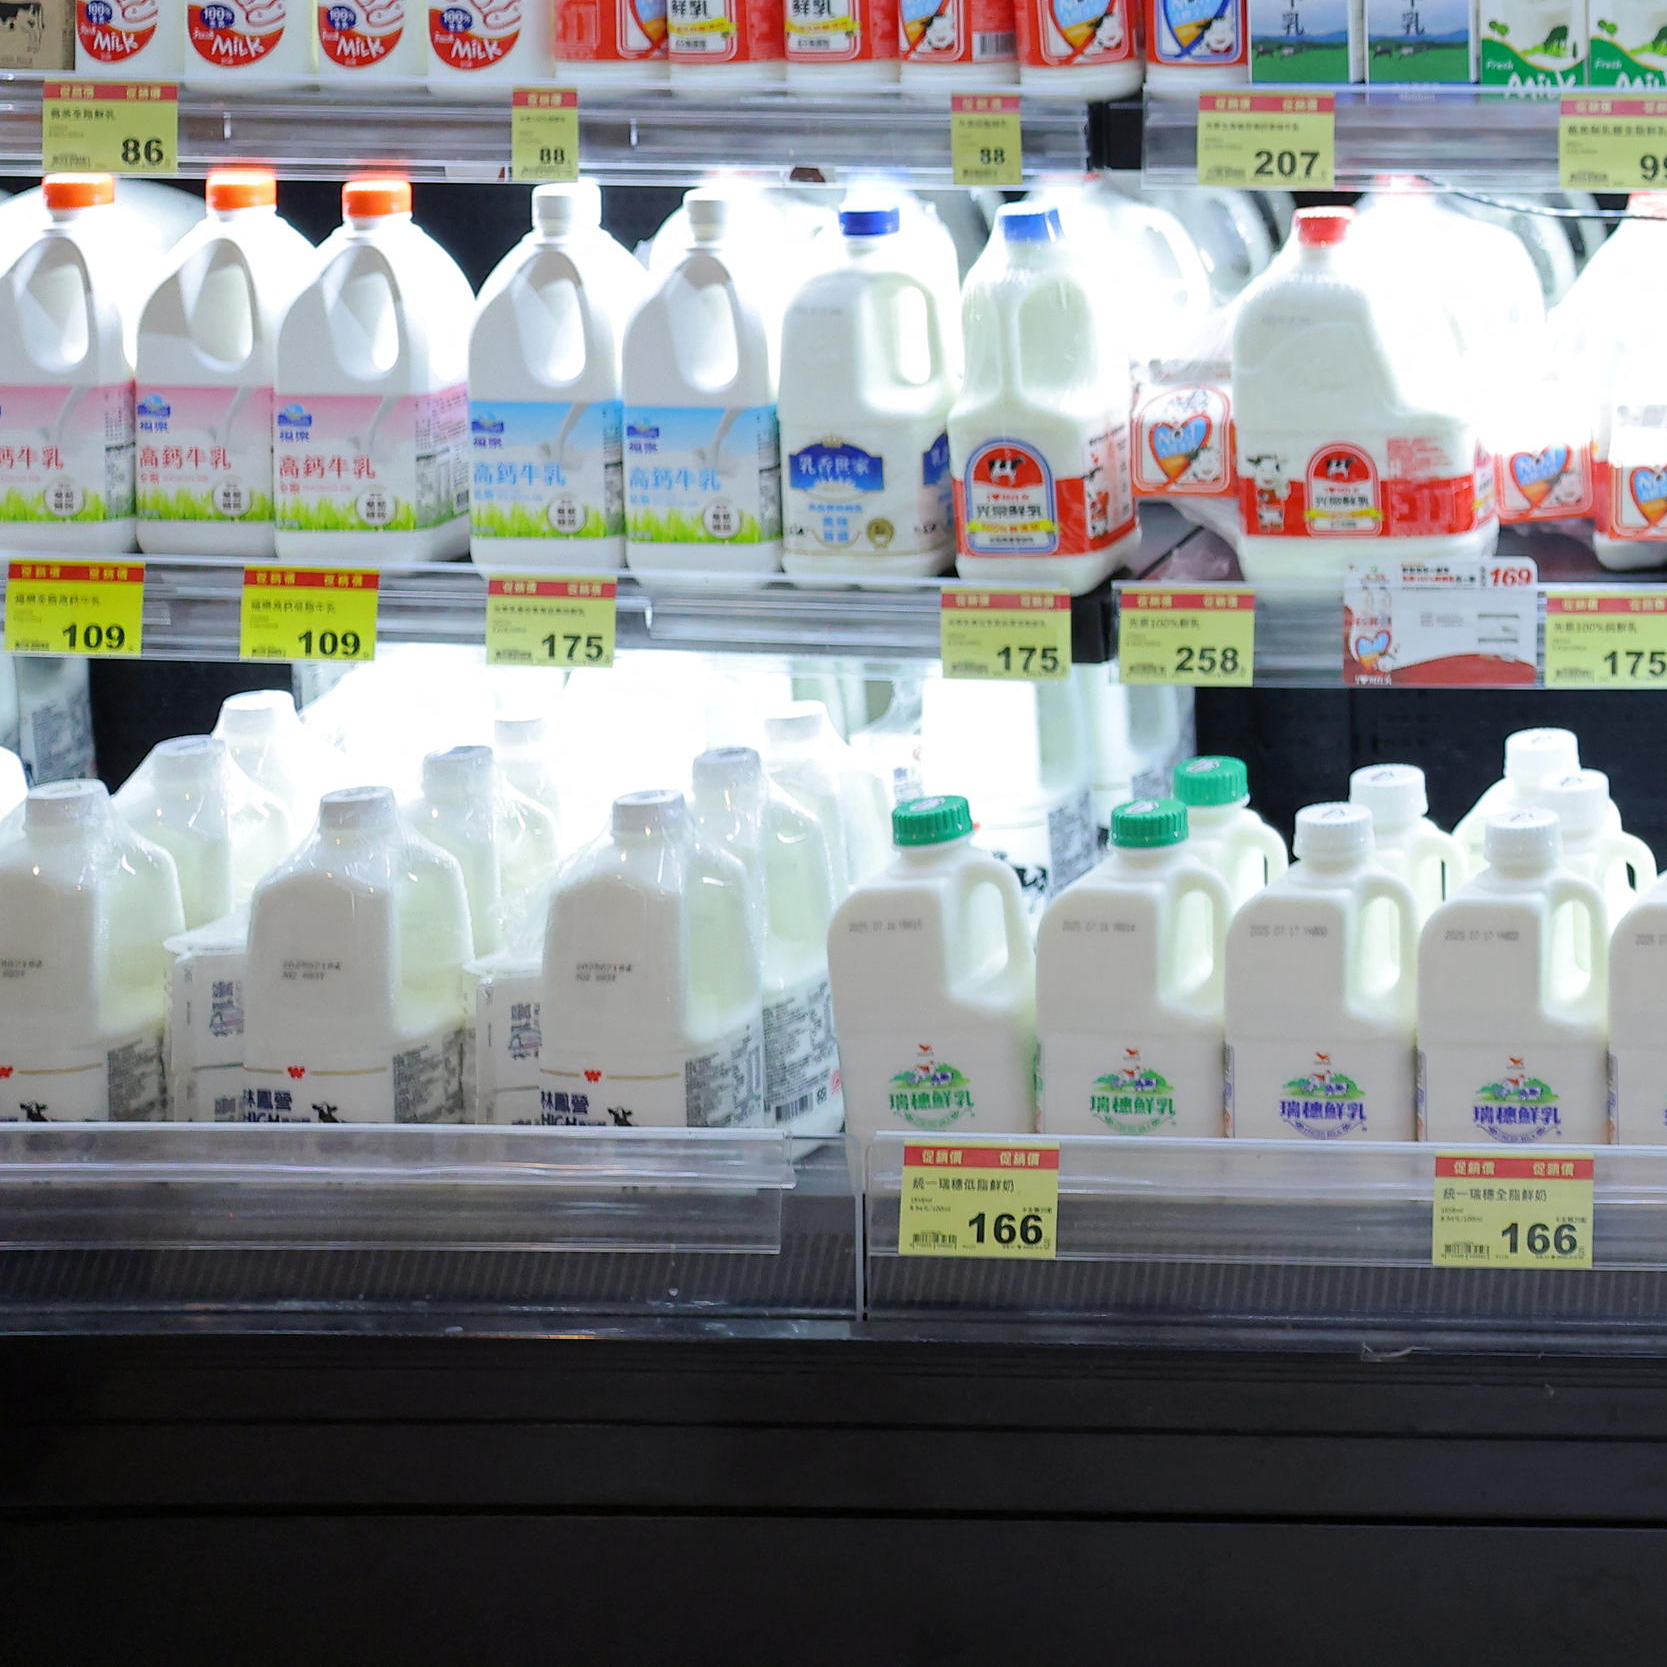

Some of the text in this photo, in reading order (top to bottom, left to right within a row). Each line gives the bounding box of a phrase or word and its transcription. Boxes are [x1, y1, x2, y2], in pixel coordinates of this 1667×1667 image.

[121, 139, 164, 163] 86
[539, 148, 565, 165] 88
[1254, 152, 1319, 177] 207
[1490, 566, 1531, 587] 169
[62, 625, 125, 650] 109
[299, 632, 361, 657] 109
[541, 635, 604, 661] 175
[997, 647, 1058, 673] 175
[1174, 647, 1239, 673] 258
[1602, 651, 1667, 678] 175
[969, 1213, 1043, 1245] 166
[1502, 1222, 1577, 1255] 166
